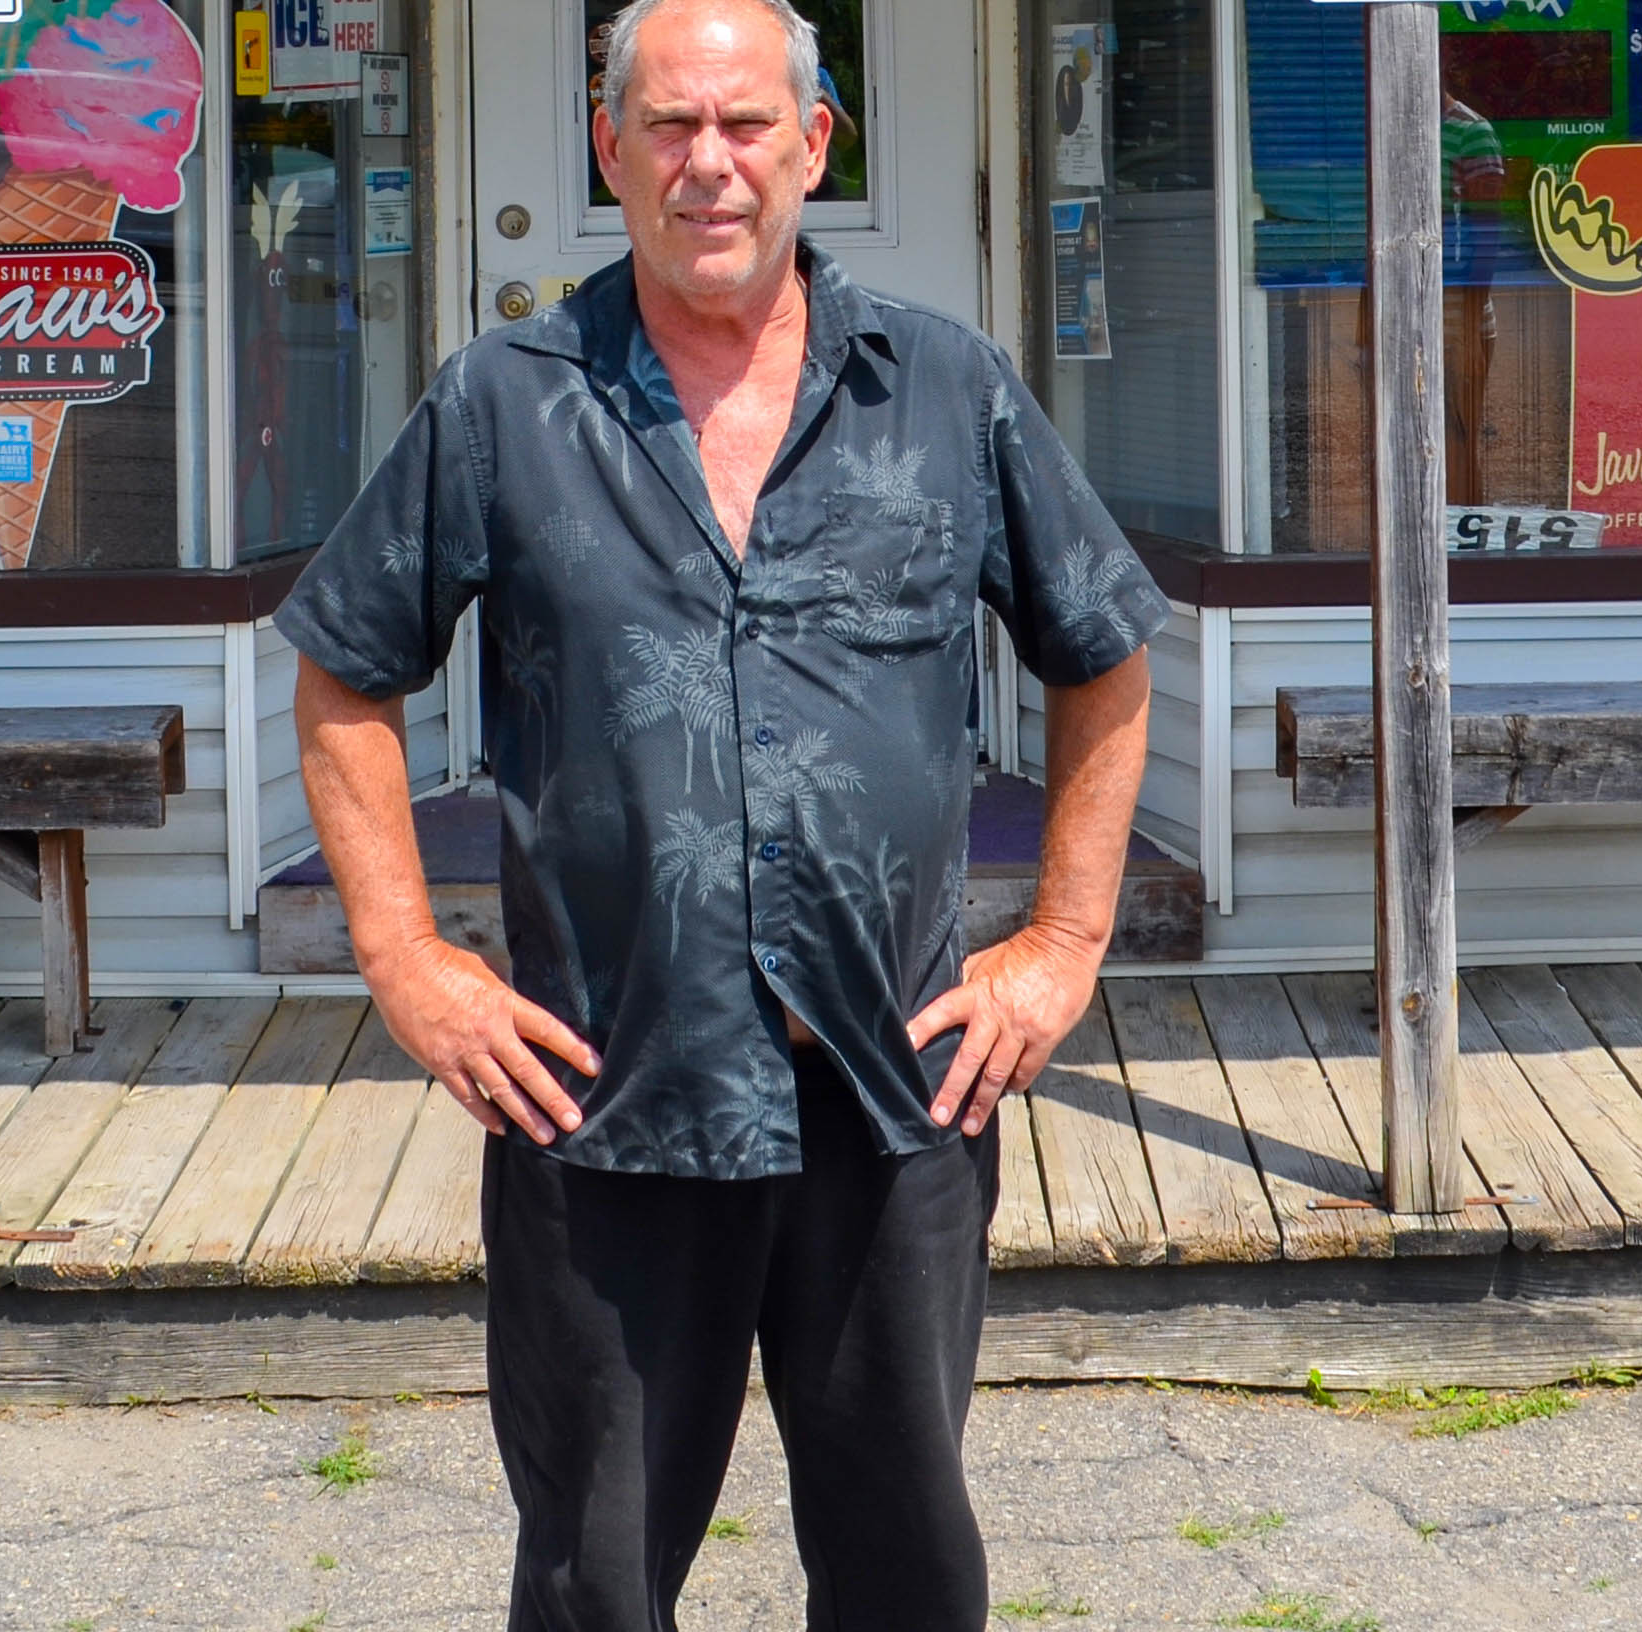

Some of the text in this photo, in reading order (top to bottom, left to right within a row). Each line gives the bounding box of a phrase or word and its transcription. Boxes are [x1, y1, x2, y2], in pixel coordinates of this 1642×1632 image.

[334, 22, 375, 51] HERE
[1630, 29, 1642, 54] $
[1547, 121, 1605, 135] MILLION
[0, 266, 104, 282] SINCE 1948
